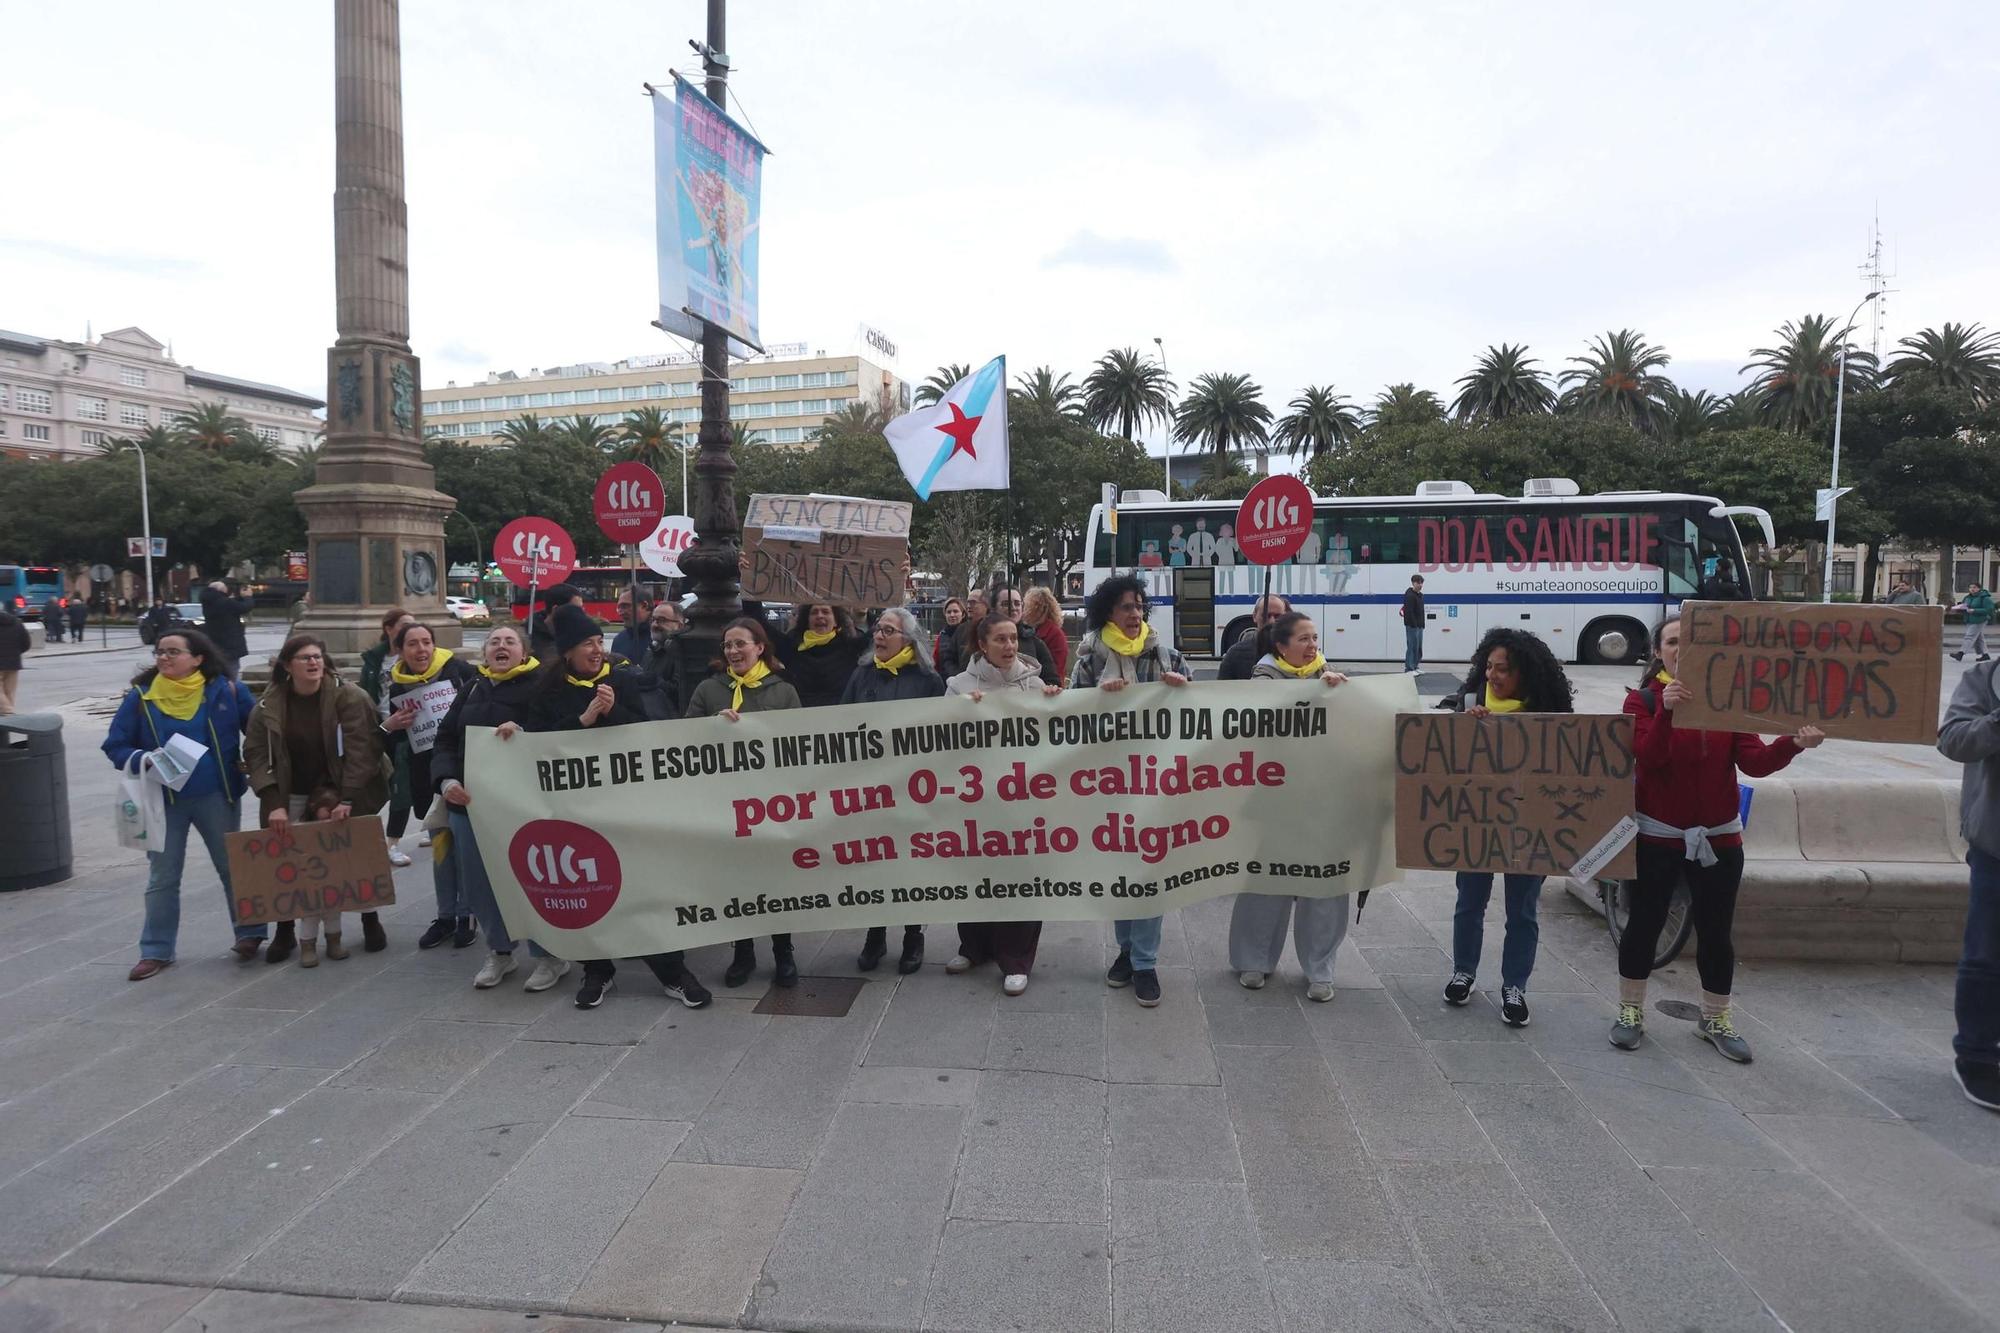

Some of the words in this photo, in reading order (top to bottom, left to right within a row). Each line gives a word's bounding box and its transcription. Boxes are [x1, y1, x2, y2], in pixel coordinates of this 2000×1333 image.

[608, 480, 651, 510] CIG
[1253, 495, 1299, 530] CIG
[749, 499, 908, 533] ESENCIALES
[1261, 536, 1287, 549] ENSINO
[1418, 518, 1494, 573] DOA
[1506, 515, 1662, 572] SANGUE
[521, 565, 548, 576] ENSNO
[1496, 578, 1659, 594] #sumateaonosoequipo
[1690, 605, 1907, 656] EDUCADORAS
[1706, 650, 1898, 720] CABREADAS
[536, 755, 602, 792] REDE
[609, 750, 645, 785] DE
[652, 739, 766, 780] ESCOLAS
[772, 723, 884, 768] INFANTÍS
[892, 716, 1040, 757] MUNICIPAIS
[1048, 708, 1172, 746] CONCELLO
[1179, 707, 1213, 740] DA
[1222, 701, 1327, 739] CORUÑA
[1396, 716, 1634, 779] CALADIÑAS
[732, 790, 816, 838] por
[830, 783, 897, 817] un
[907, 765, 985, 804] 0-3
[996, 761, 1057, 801] de
[1070, 751, 1286, 796] calidade
[1420, 779, 1519, 825] MÁIS
[243, 832, 304, 860] POR
[317, 831, 352, 852] UN
[792, 847, 821, 869] e
[832, 833, 898, 866] un
[910, 816, 1080, 858] salario
[1092, 812, 1230, 864] digno
[1423, 823, 1581, 872] GUAPAS
[276, 856, 329, 884] 0-3
[527, 844, 599, 885] CIG
[238, 895, 267, 919] DE
[544, 898, 588, 910] ENSINO
[675, 905, 717, 926] Na
[723, 893, 832, 919] defensa
[837, 885, 885, 906] dos
[891, 885, 968, 903] nosos
[975, 876, 1083, 900] dereitos
[1088, 882, 1104, 898] e
[1110, 876, 1159, 898] dos
[1164, 860, 1240, 892] nenos
[1246, 860, 1262, 874] e
[1269, 859, 1351, 879] nenas
